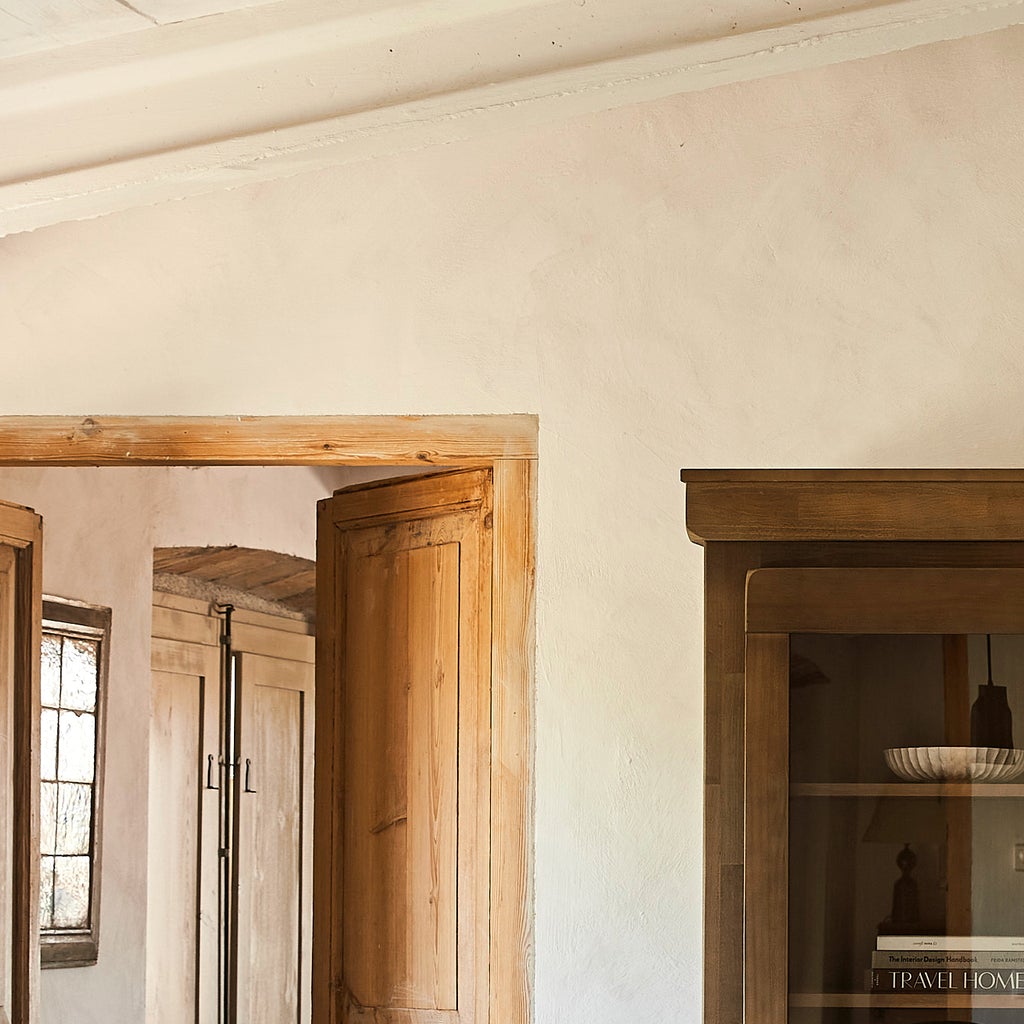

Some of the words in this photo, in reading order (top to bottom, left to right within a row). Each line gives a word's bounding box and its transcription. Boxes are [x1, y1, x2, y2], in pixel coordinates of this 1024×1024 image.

[924, 956, 944, 964] Design
[946, 955, 978, 963] Handbook
[889, 972, 958, 989] TRAVEL
